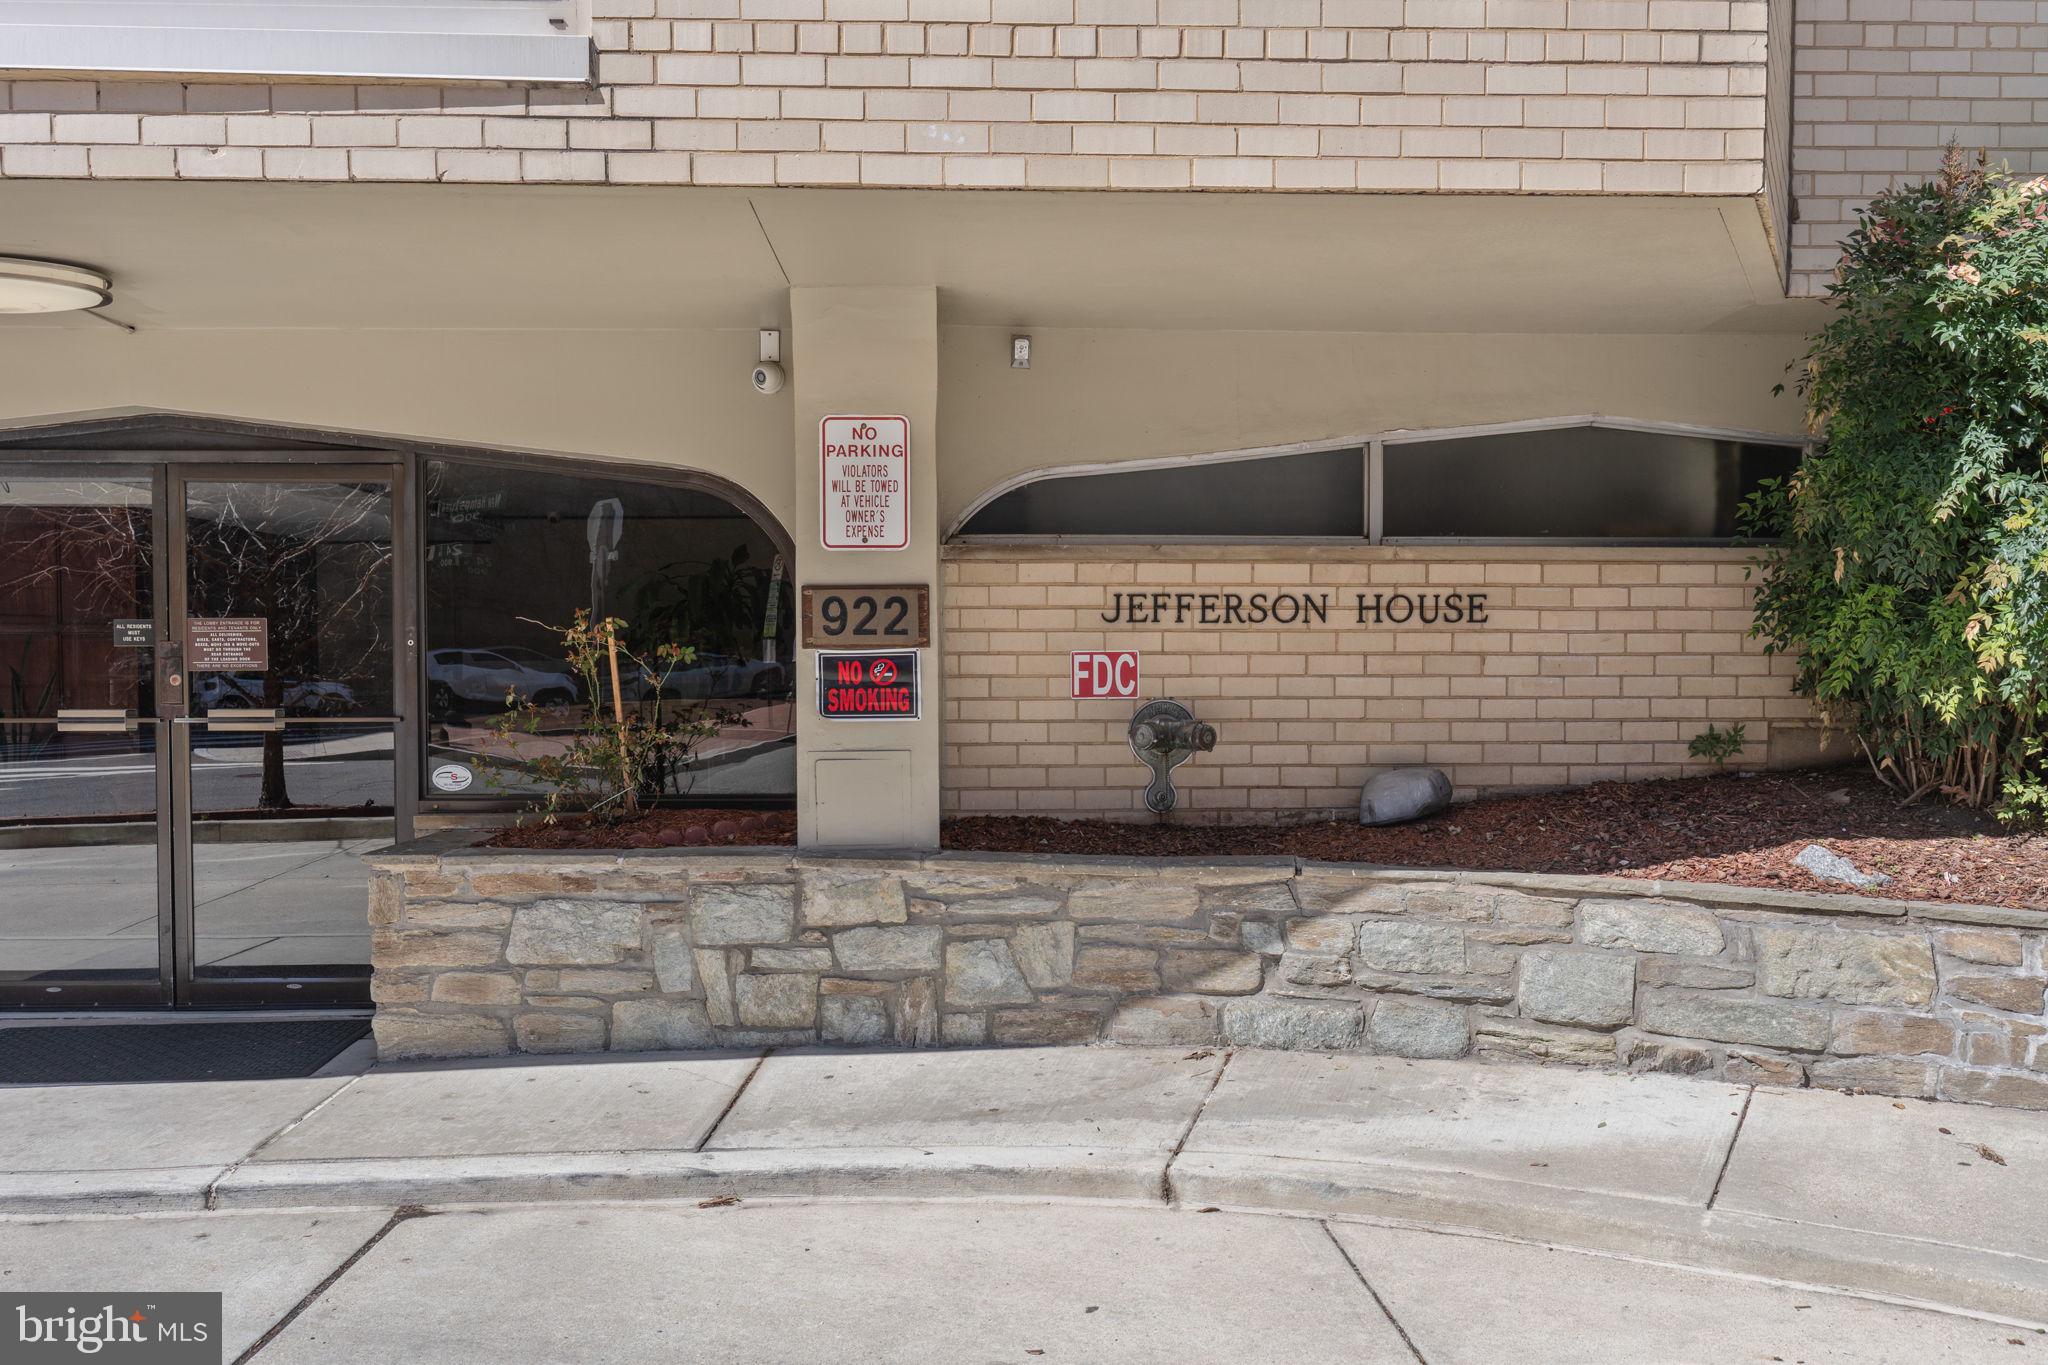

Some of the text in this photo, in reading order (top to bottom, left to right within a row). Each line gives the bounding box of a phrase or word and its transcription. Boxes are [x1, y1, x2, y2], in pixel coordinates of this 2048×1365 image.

[852, 427, 877, 440] NO
[826, 444, 904, 457] PARKING
[842, 464, 889, 478] VIOLATORS
[832, 480, 899, 493] WILL BE TOWED
[840, 495, 890, 508] AT VEHICLE
[845, 510, 886, 523] OWNER'S
[845, 525, 885, 538] EXPENSE
[1101, 593, 1489, 624] JEFFERSON HOUSE
[821, 595, 909, 636] 922
[837, 660, 863, 685] NO
[1072, 654, 1136, 696] FDC
[827, 687, 910, 712] SMOKING
